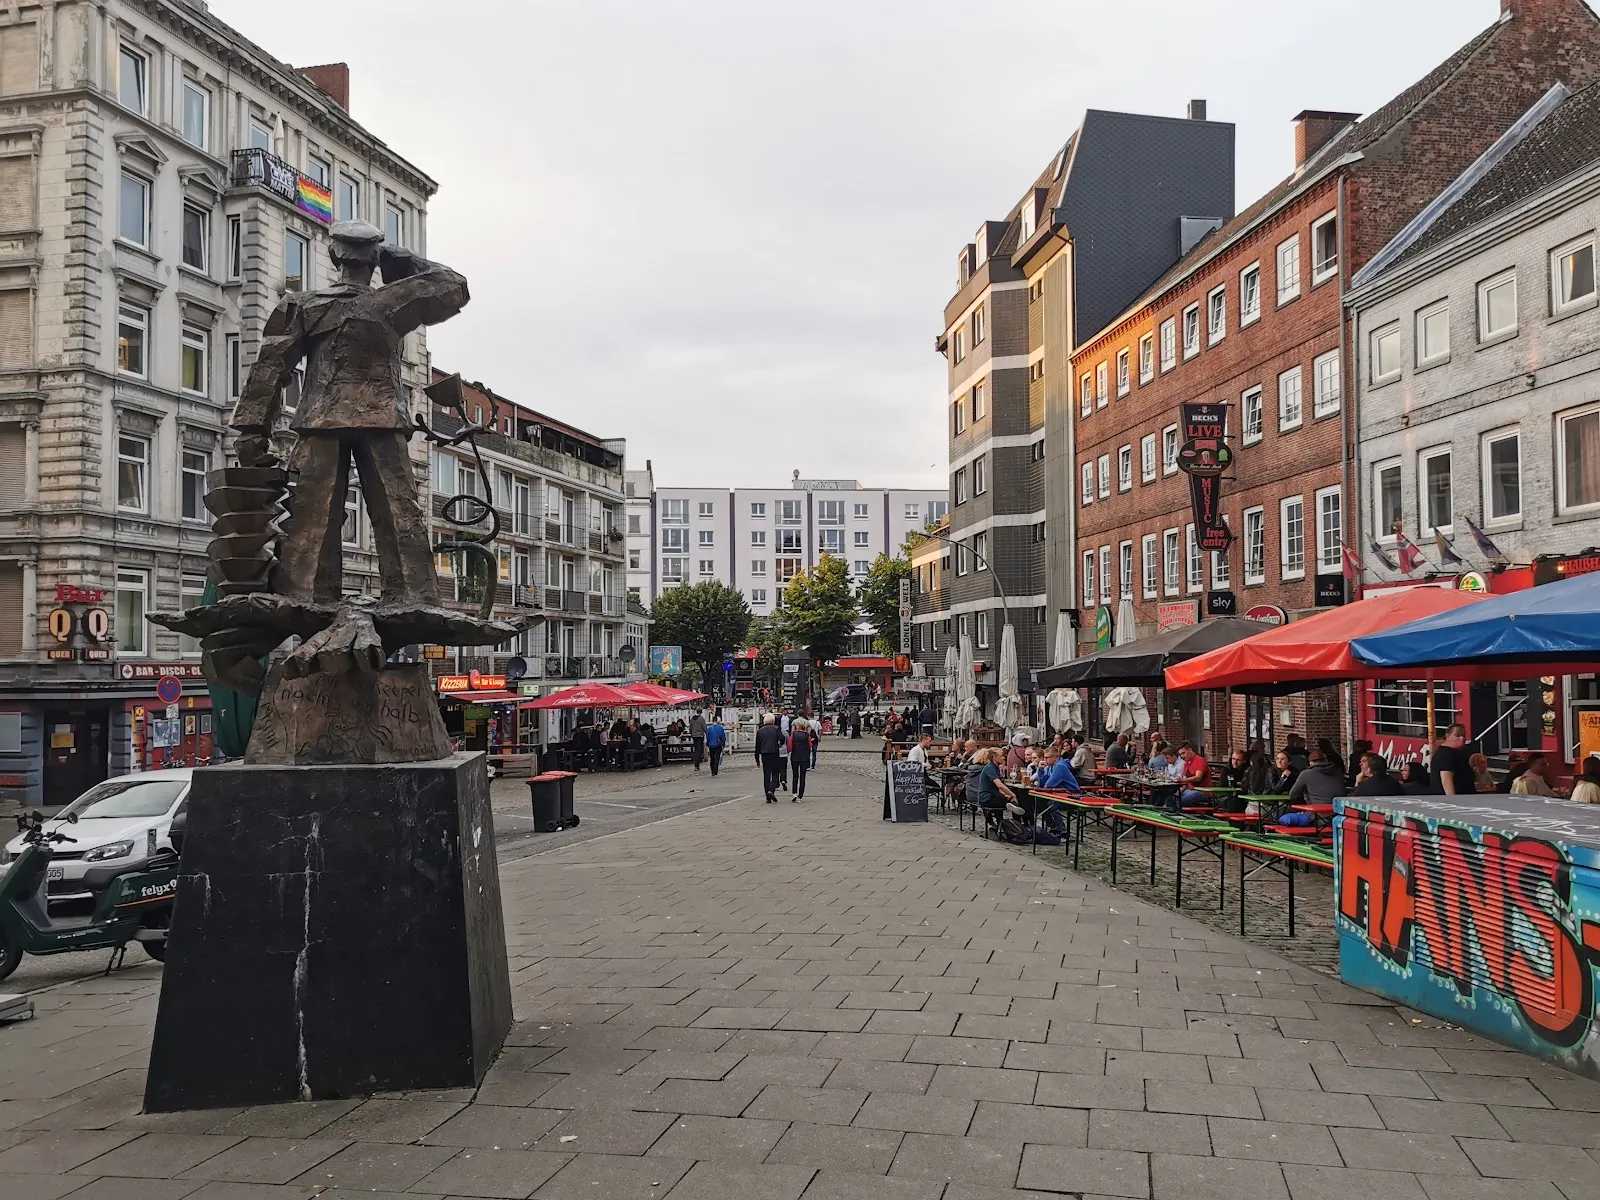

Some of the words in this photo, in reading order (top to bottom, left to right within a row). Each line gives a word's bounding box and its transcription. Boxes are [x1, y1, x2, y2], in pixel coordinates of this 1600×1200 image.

[270, 179, 295, 200] MATTER
[1188, 425, 1222, 437] LIVE
[1201, 478, 1211, 523] MUSIC
[1206, 528, 1224, 537] free
[1203, 538, 1228, 548] entry
[56, 584, 108, 602] Bar
[1213, 597, 1231, 609] sky
[49, 609, 71, 642] Q
[87, 609, 108, 642] Q
[136, 667, 153, 676] BAR
[160, 666, 186, 676] DISCO
[141, 883, 171, 897] felyx
